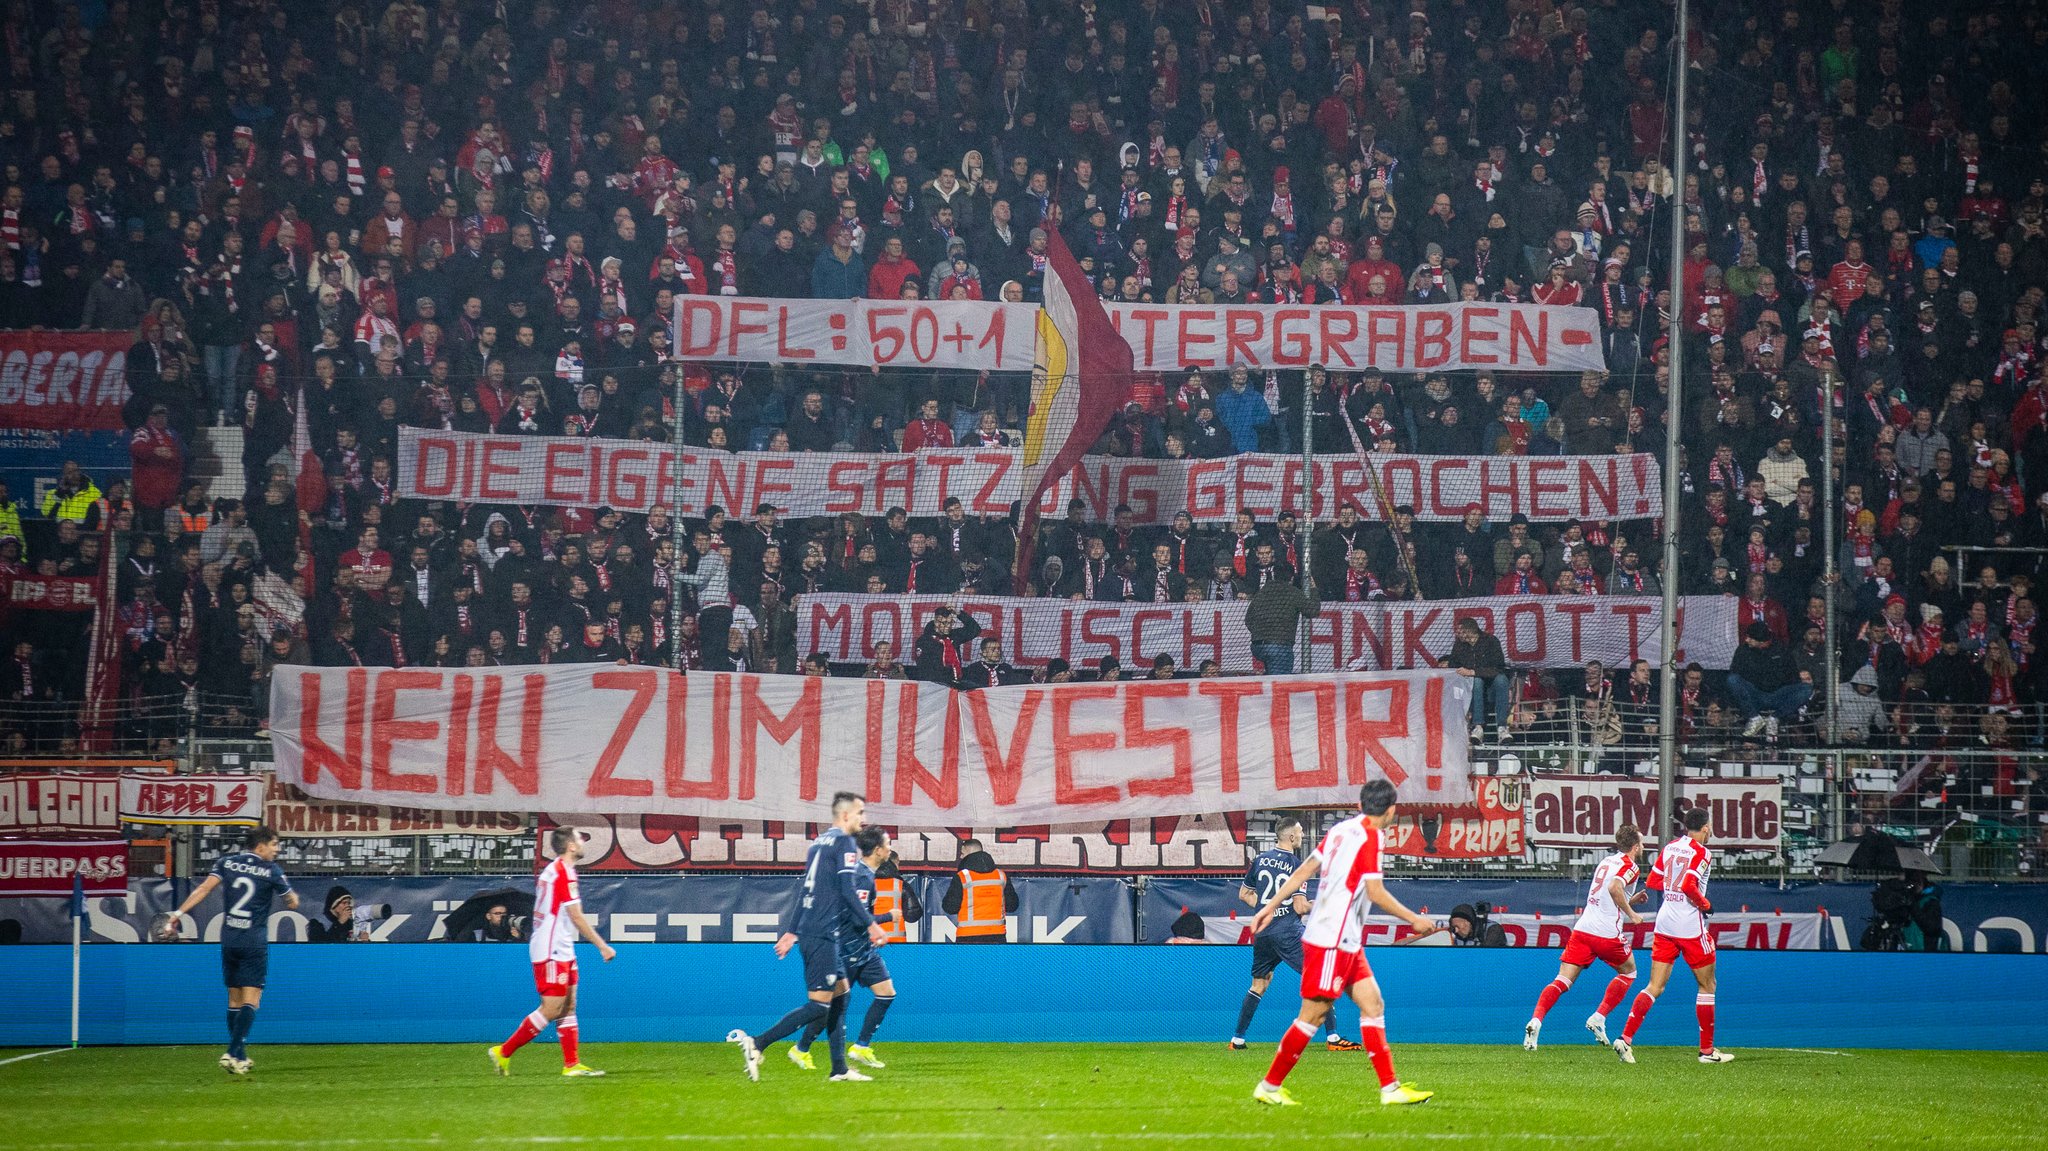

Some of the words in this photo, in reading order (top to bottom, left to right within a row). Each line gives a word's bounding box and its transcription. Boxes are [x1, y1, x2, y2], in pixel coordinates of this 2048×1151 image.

[867, 303, 1006, 365] 50+1
[1034, 308, 1593, 368] TERGRABEN-
[0, 349, 134, 407] BERTA
[415, 437, 520, 499] DIE
[544, 443, 795, 517] EIGENE
[1186, 455, 1650, 521] GEBROCHEN!
[301, 669, 544, 796] NEIN
[587, 670, 822, 800] ZUM
[866, 676, 1445, 808] INVESTOR!
[136, 783, 249, 816] REBELS
[267, 805, 378, 832] IMMER
[389, 806, 444, 830] BEI
[455, 810, 520, 831] UNS
[1534, 786, 1779, 840] alarMstufe
[1449, 817, 1521, 853] PRIDE
[224, 859, 271, 878] BOCHUM
[804, 847, 821, 893] 4
[1259, 857, 1294, 874] BOCHUM
[1591, 865, 1609, 895] 9
[230, 876, 256, 918] 2
